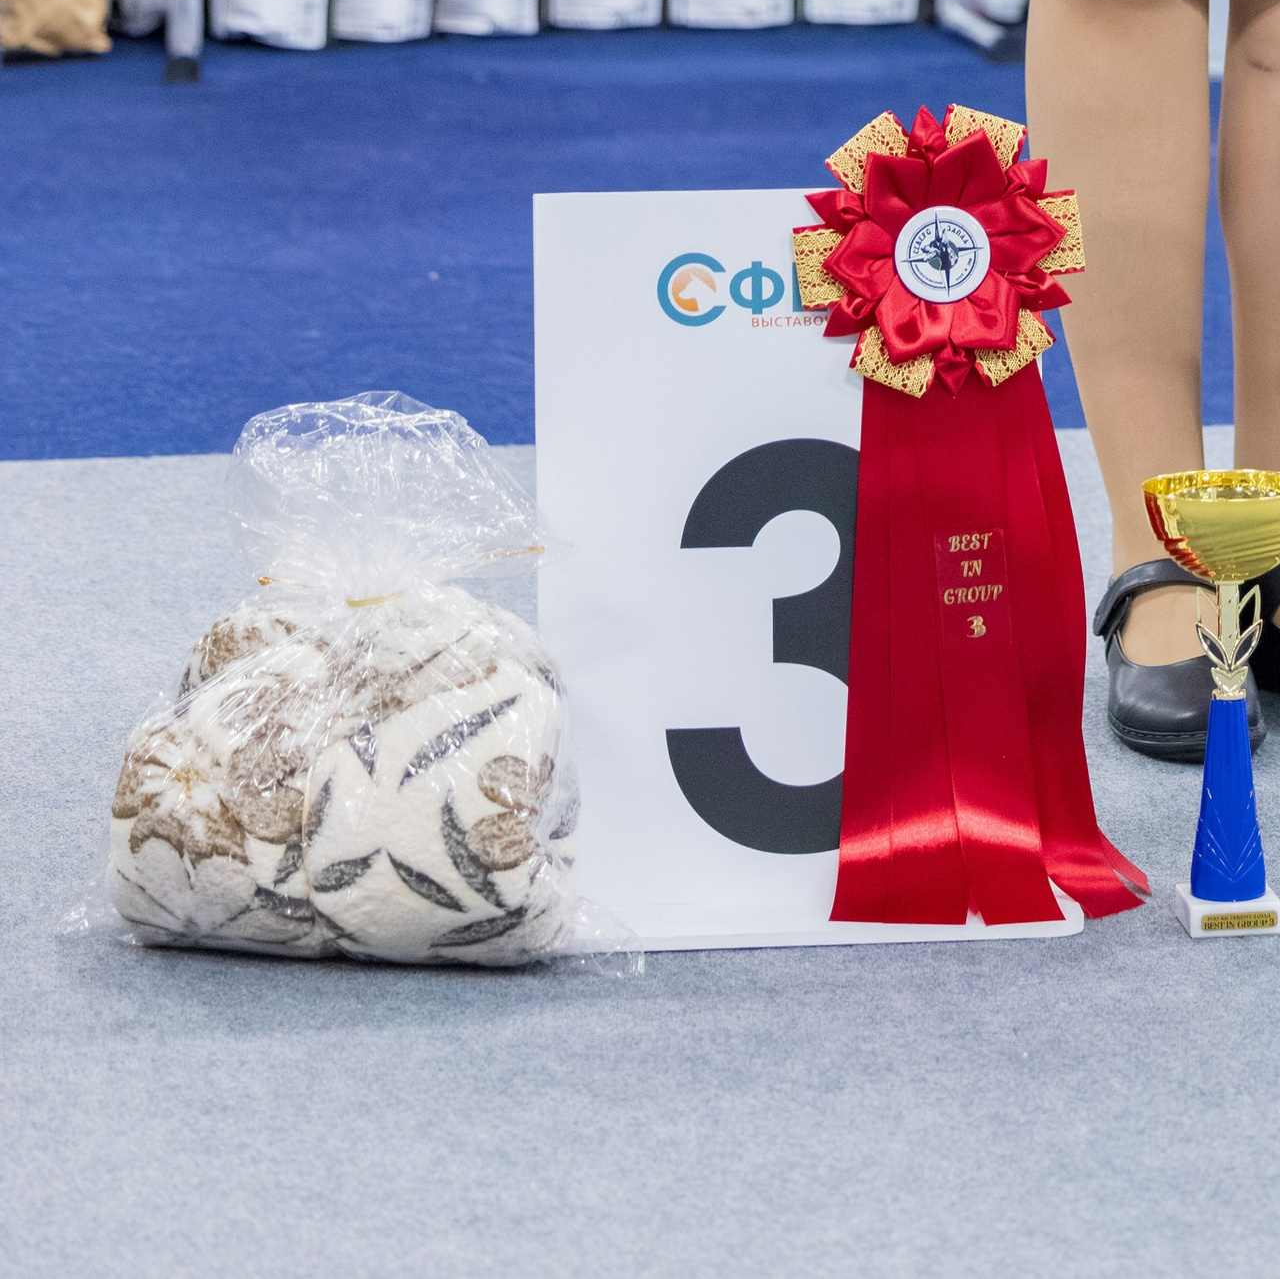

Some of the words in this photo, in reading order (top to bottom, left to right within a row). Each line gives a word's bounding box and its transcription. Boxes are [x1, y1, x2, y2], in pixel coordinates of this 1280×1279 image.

[948, 532, 993, 553] BEST
[960, 559, 983, 577] IN
[943, 584, 1004, 605] GROUP
[966, 615, 987, 638] 3
[665, 437, 860, 855] 3
[1204, 921, 1225, 930] BEST
[1226, 921, 1235, 929] IN
[1237, 919, 1267, 928] GROUP
[1269, 918, 1275, 927] 3
